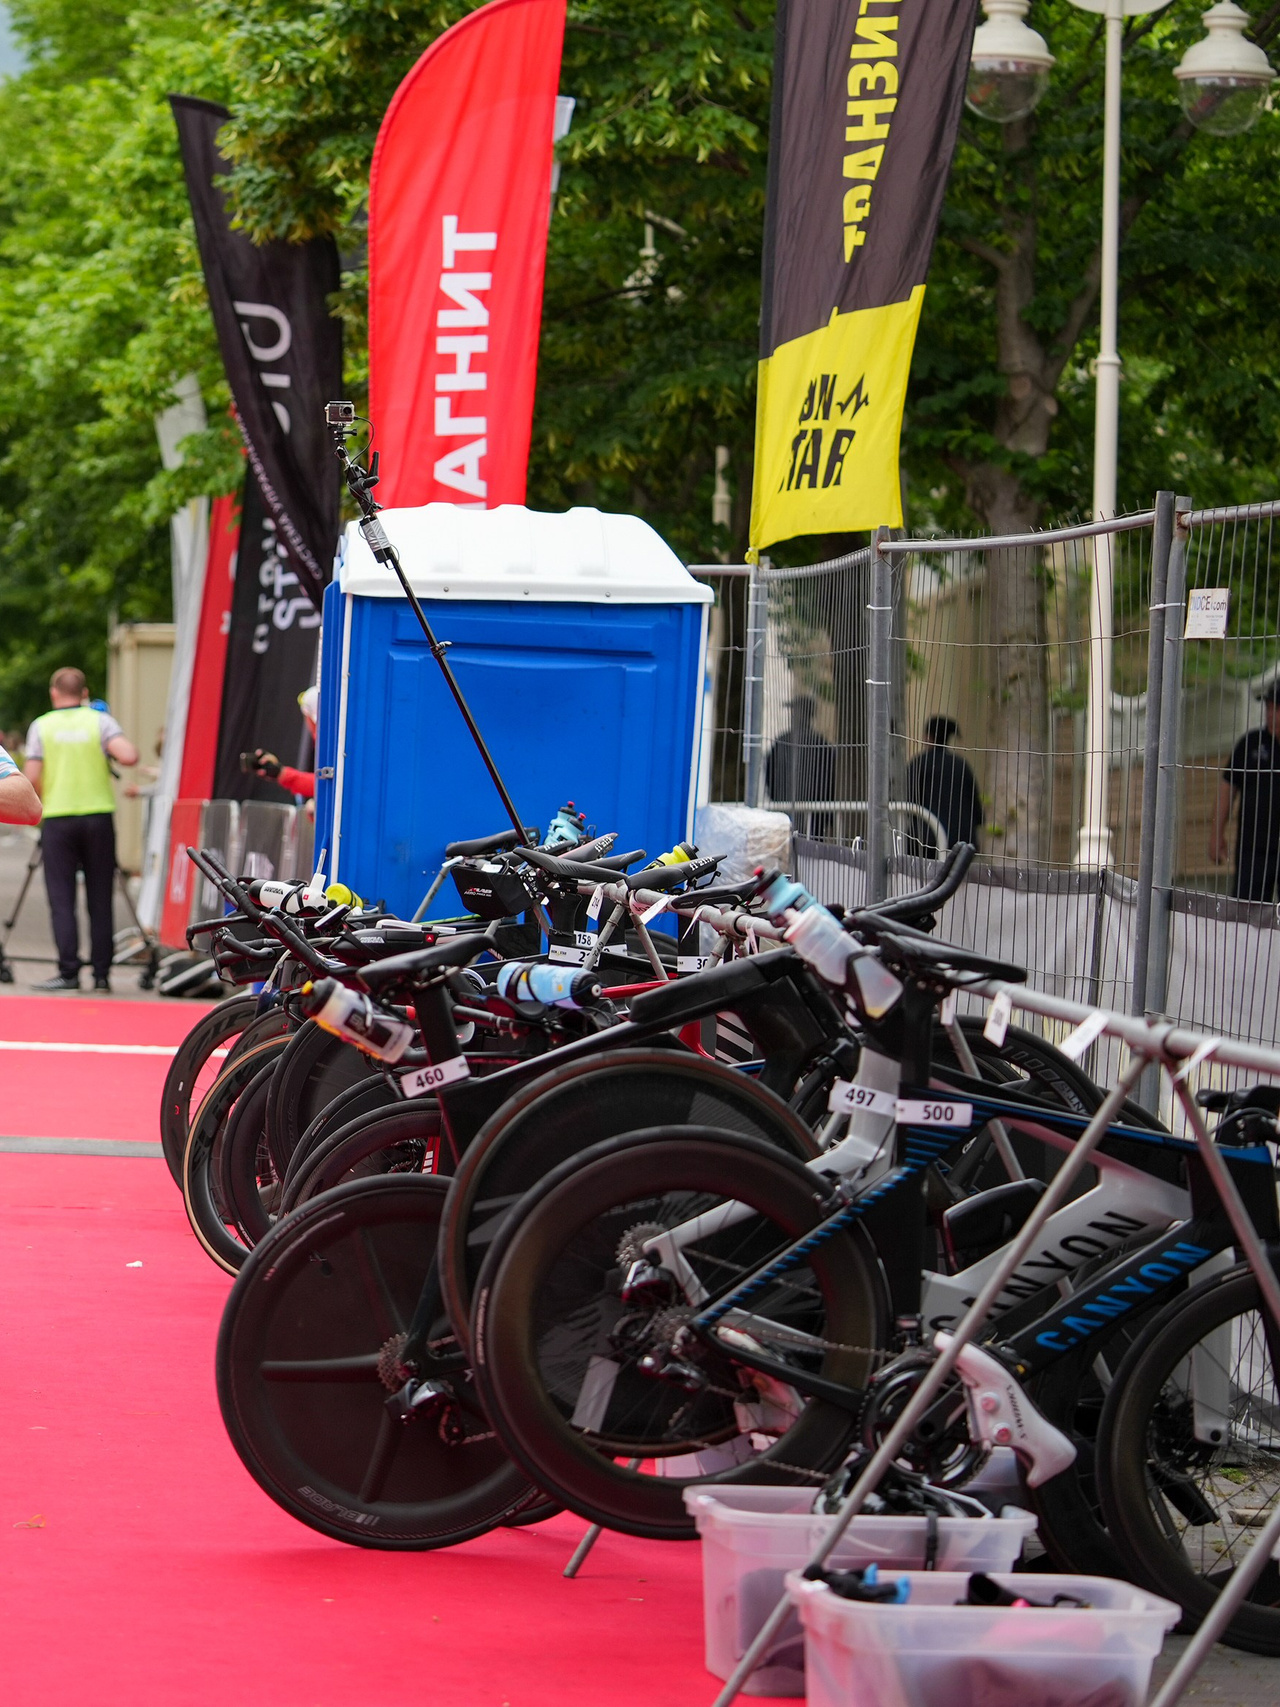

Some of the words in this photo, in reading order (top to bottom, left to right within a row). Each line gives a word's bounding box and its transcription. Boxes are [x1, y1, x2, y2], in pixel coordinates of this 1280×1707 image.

[432, 214, 498, 509] АГНИТ
[577, 933, 592, 946] 158
[415, 1067, 444, 1089] 460
[844, 1086, 876, 1107] 497
[921, 1104, 955, 1122] 500
[1035, 1241, 1213, 1352] CANYON
